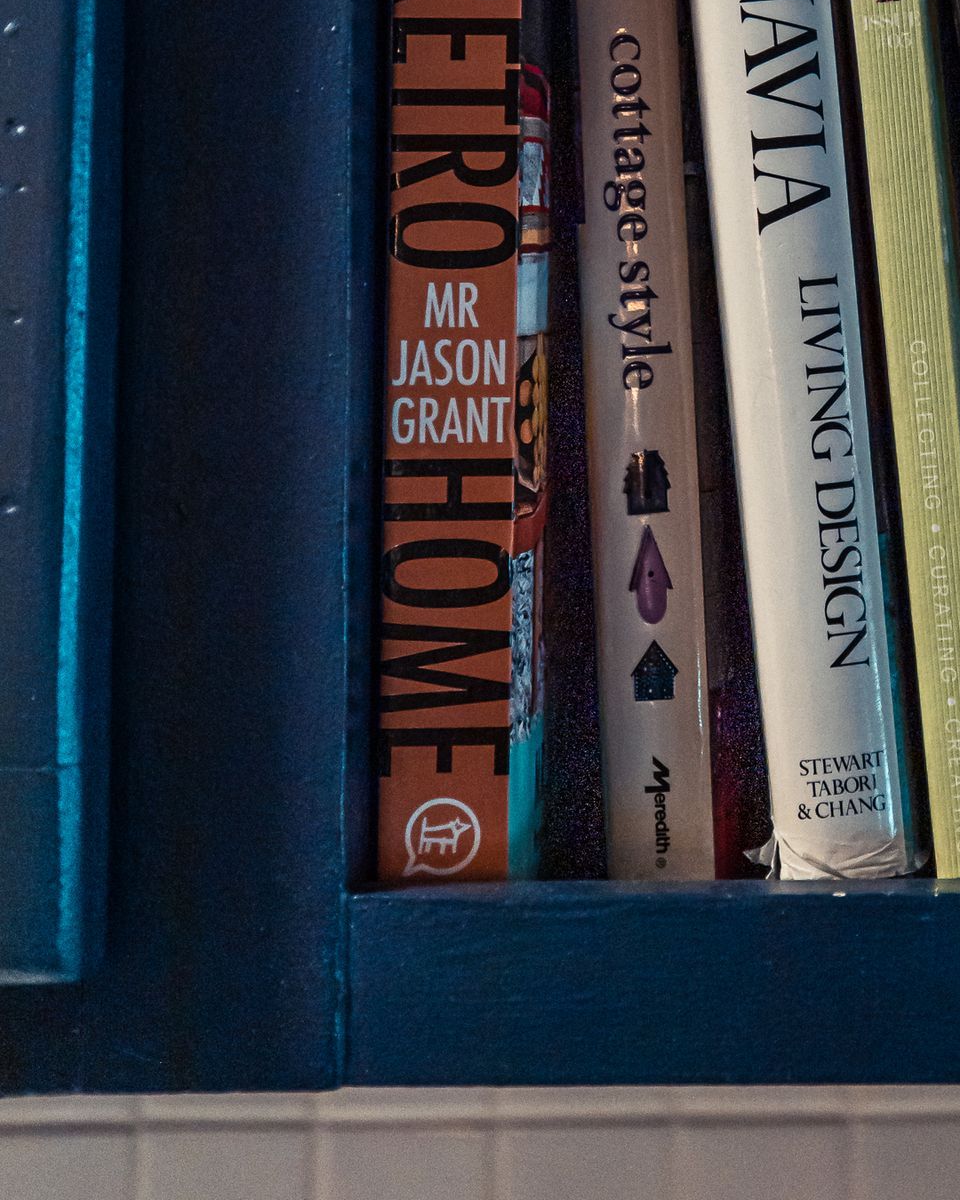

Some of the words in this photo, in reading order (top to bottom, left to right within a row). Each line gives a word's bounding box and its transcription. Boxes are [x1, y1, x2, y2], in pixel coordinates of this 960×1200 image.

[603, 33, 652, 243] cottage
[424, 282, 479, 329] MR
[608, 260, 673, 392] style
[392, 338, 507, 387] JASON
[799, 273, 856, 462] LIVING
[391, 397, 511, 445] GRANT
[909, 339, 941, 510] COLLECTING
[930, 543, 957, 685] CURATING
[379, 458, 512, 778] HOME
[816, 481, 869, 670] DESIGN
[797, 803, 812, 820] &
[815, 794, 886, 819] CHANG
[799, 750, 885, 776] STEWART
[807, 774, 877, 798] TABORI
